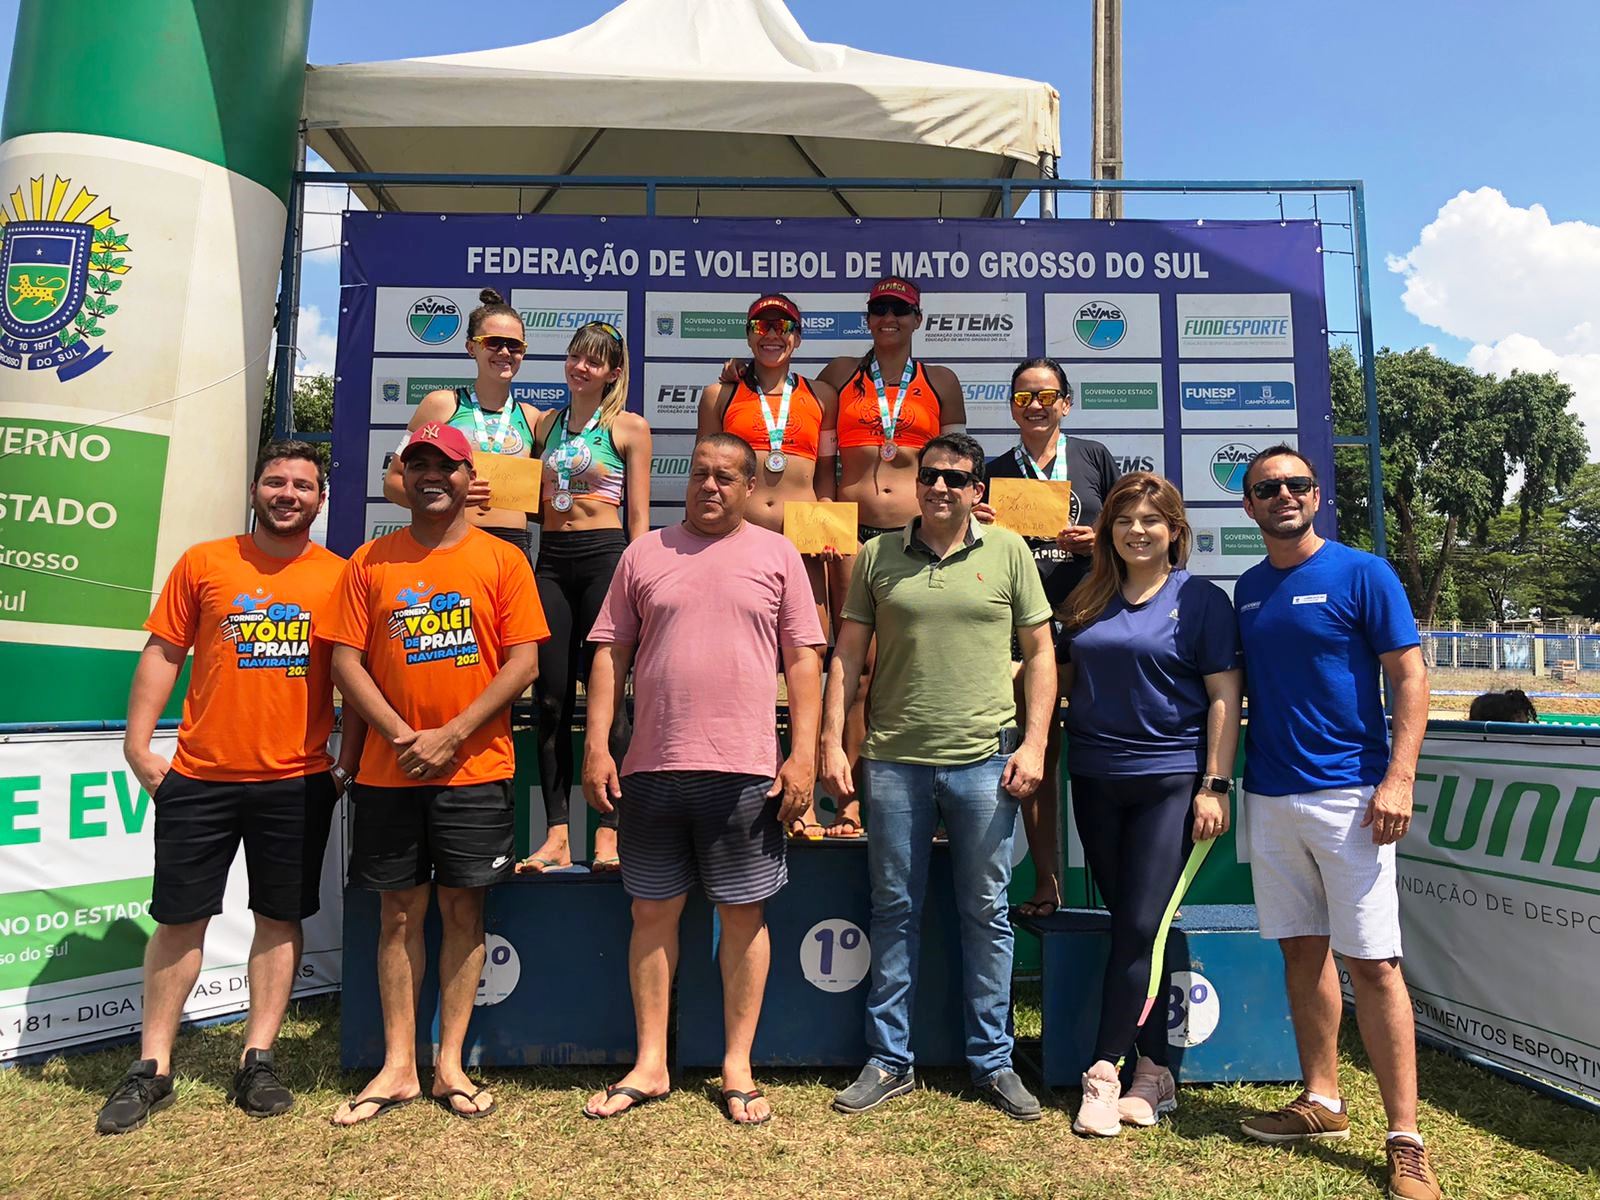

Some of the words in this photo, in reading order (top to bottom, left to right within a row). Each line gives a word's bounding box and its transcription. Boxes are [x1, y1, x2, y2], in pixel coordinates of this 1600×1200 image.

[467, 243, 640, 282] FEDERAÇÃO
[649, 250, 686, 276] DE
[695, 250, 835, 279] VOLEIBOL
[845, 251, 882, 278] DE
[891, 251, 970, 279] MATO
[979, 252, 1096, 279] GROSSO
[1106, 252, 1145, 279] DO
[1154, 252, 1209, 279] SUL
[925, 313, 1013, 331] FETEMS
[1184, 319, 1289, 335] FUNDESPORTE
[19, 342, 28, 350] 10
[34, 340, 53, 350] 1977
[37, 358, 52, 367] DO
[57, 348, 81, 362] SUL
[514, 389, 564, 399] FUNESP
[658, 385, 702, 402] FET
[912, 388, 922, 396] 2
[1186, 388, 1235, 398] FUNESP
[0, 427, 111, 462] ERNO
[593, 436, 603, 446] 2
[650, 458, 690, 474] FUND
[229, 614, 264, 622] TORNEIO
[268, 604, 300, 620] GP
[299, 612, 310, 620] DE
[394, 607, 427, 618] TORNEIO
[431, 593, 460, 611] GP
[460, 599, 471, 607] DE
[240, 617, 309, 641] VÔLEI
[405, 607, 471, 637] VÔLEI
[406, 638, 419, 648] DE
[421, 628, 475, 650] PRAIA
[238, 643, 253, 652] DE
[253, 641, 310, 656] PRAIA
[408, 644, 478, 662] NAVIRAÍ-MS
[457, 654, 478, 667] 2021
[288, 667, 308, 676] 202
[1397, 874, 1478, 907] NDAÇÃO
[1486, 893, 1514, 915] DE
[36, 911, 69, 932] DO
[20, 947, 41, 961] do
[45, 941, 68, 958] Sul
[815, 928, 860, 975] 1º
[13, 1013, 51, 1034] 181
[78, 998, 135, 1023] DIGA
[1413, 999, 1506, 1046] STIMENTOS
